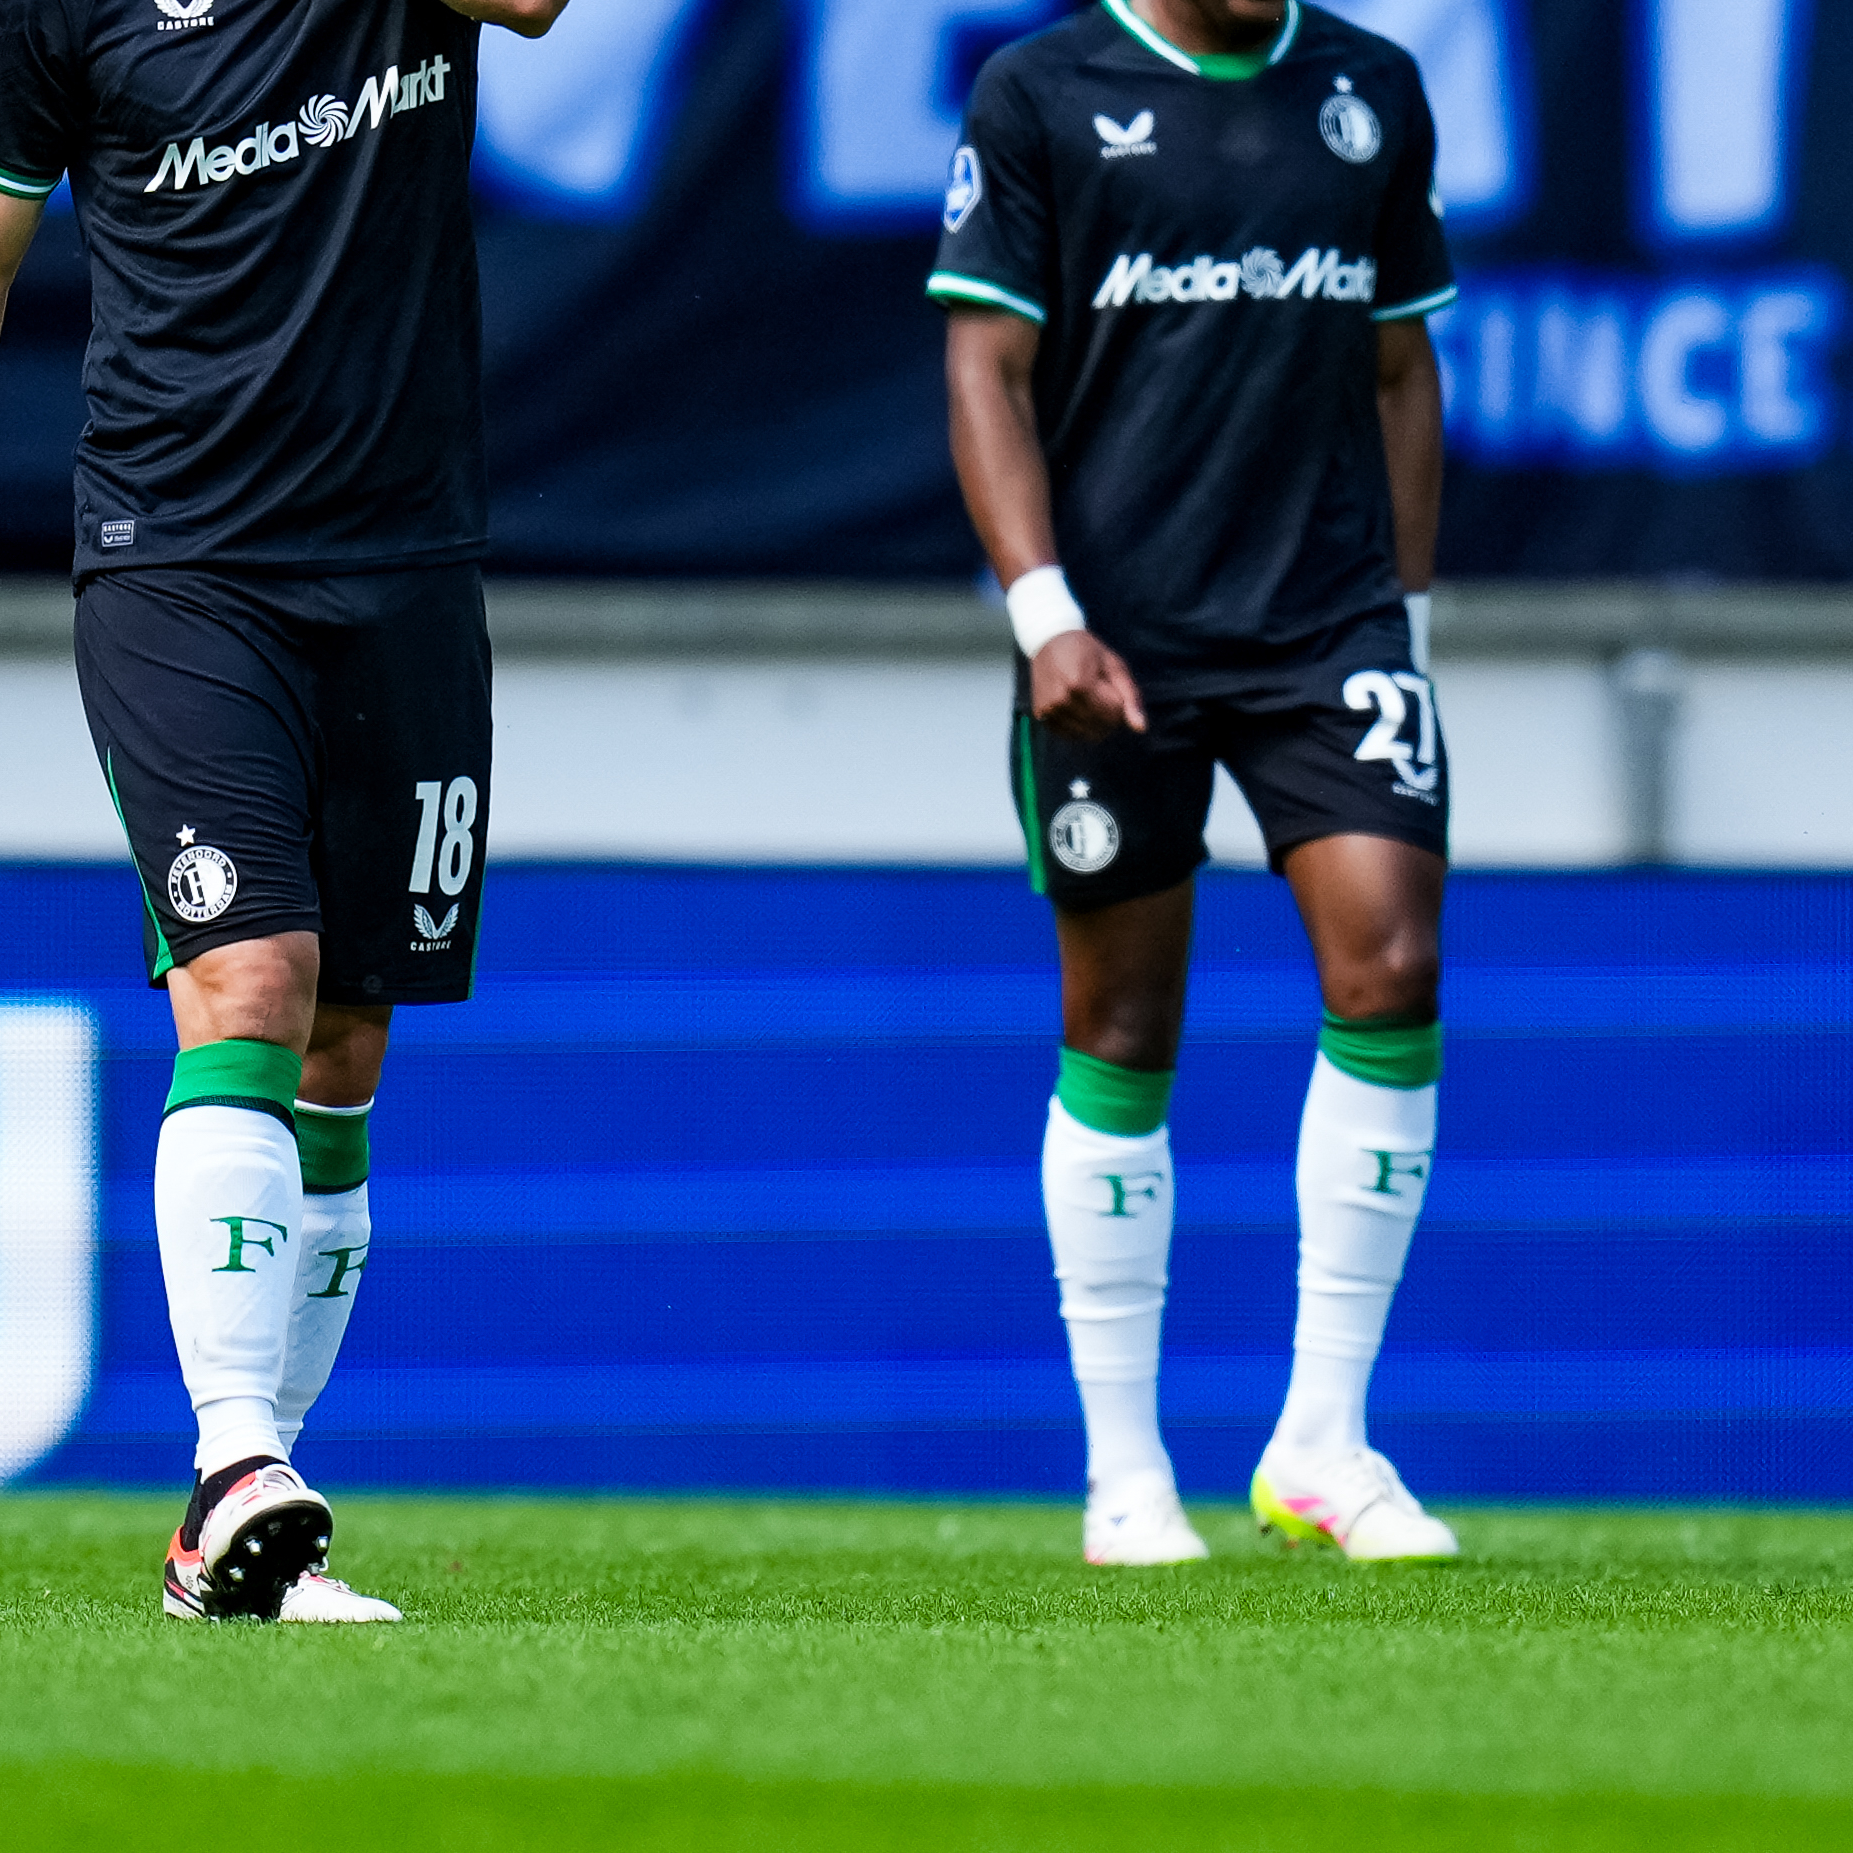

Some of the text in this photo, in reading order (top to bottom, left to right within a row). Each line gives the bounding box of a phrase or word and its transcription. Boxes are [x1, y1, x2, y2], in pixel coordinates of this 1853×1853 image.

[1343, 669, 1436, 765] 27
[408, 776, 478, 896] 18
[1092, 1170, 1165, 1218] F
[1361, 1148, 1432, 1196] F
[209, 1215, 288, 1273] F
[306, 1243, 370, 1298] F
